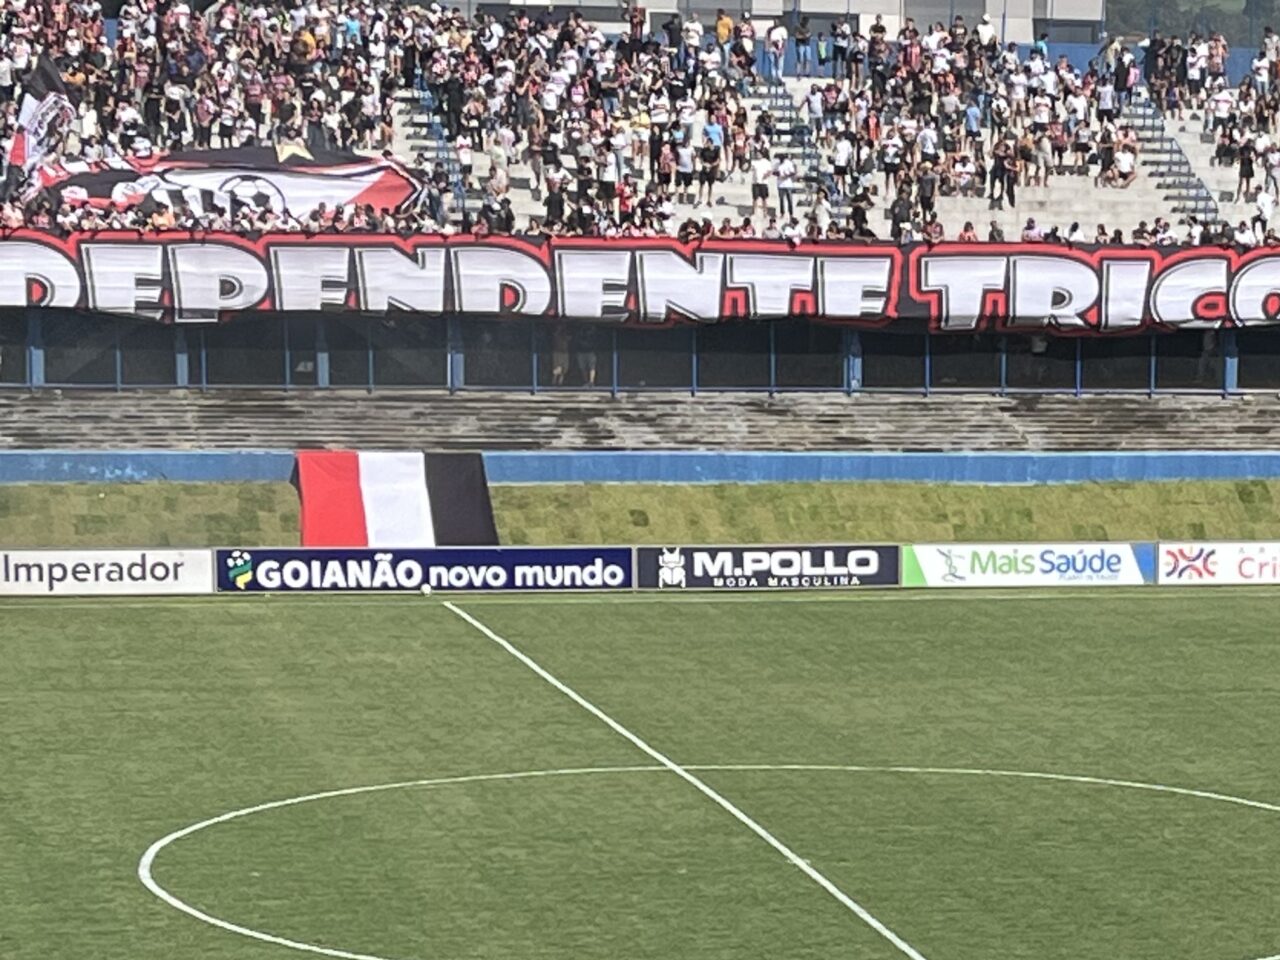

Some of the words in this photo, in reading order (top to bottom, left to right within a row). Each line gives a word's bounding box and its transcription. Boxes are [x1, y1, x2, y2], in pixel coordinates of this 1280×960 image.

[3, 553, 184, 591] Imperador
[256, 553, 423, 588] GOIANÃO
[430, 564, 507, 587] novo
[514, 558, 624, 587] mundo
[692, 550, 879, 577] M.POLLO
[969, 550, 1035, 575] Mais
[1039, 548, 1121, 574] Saúde
[713, 577, 758, 587] MODA
[768, 577, 861, 587] MASCULINA
